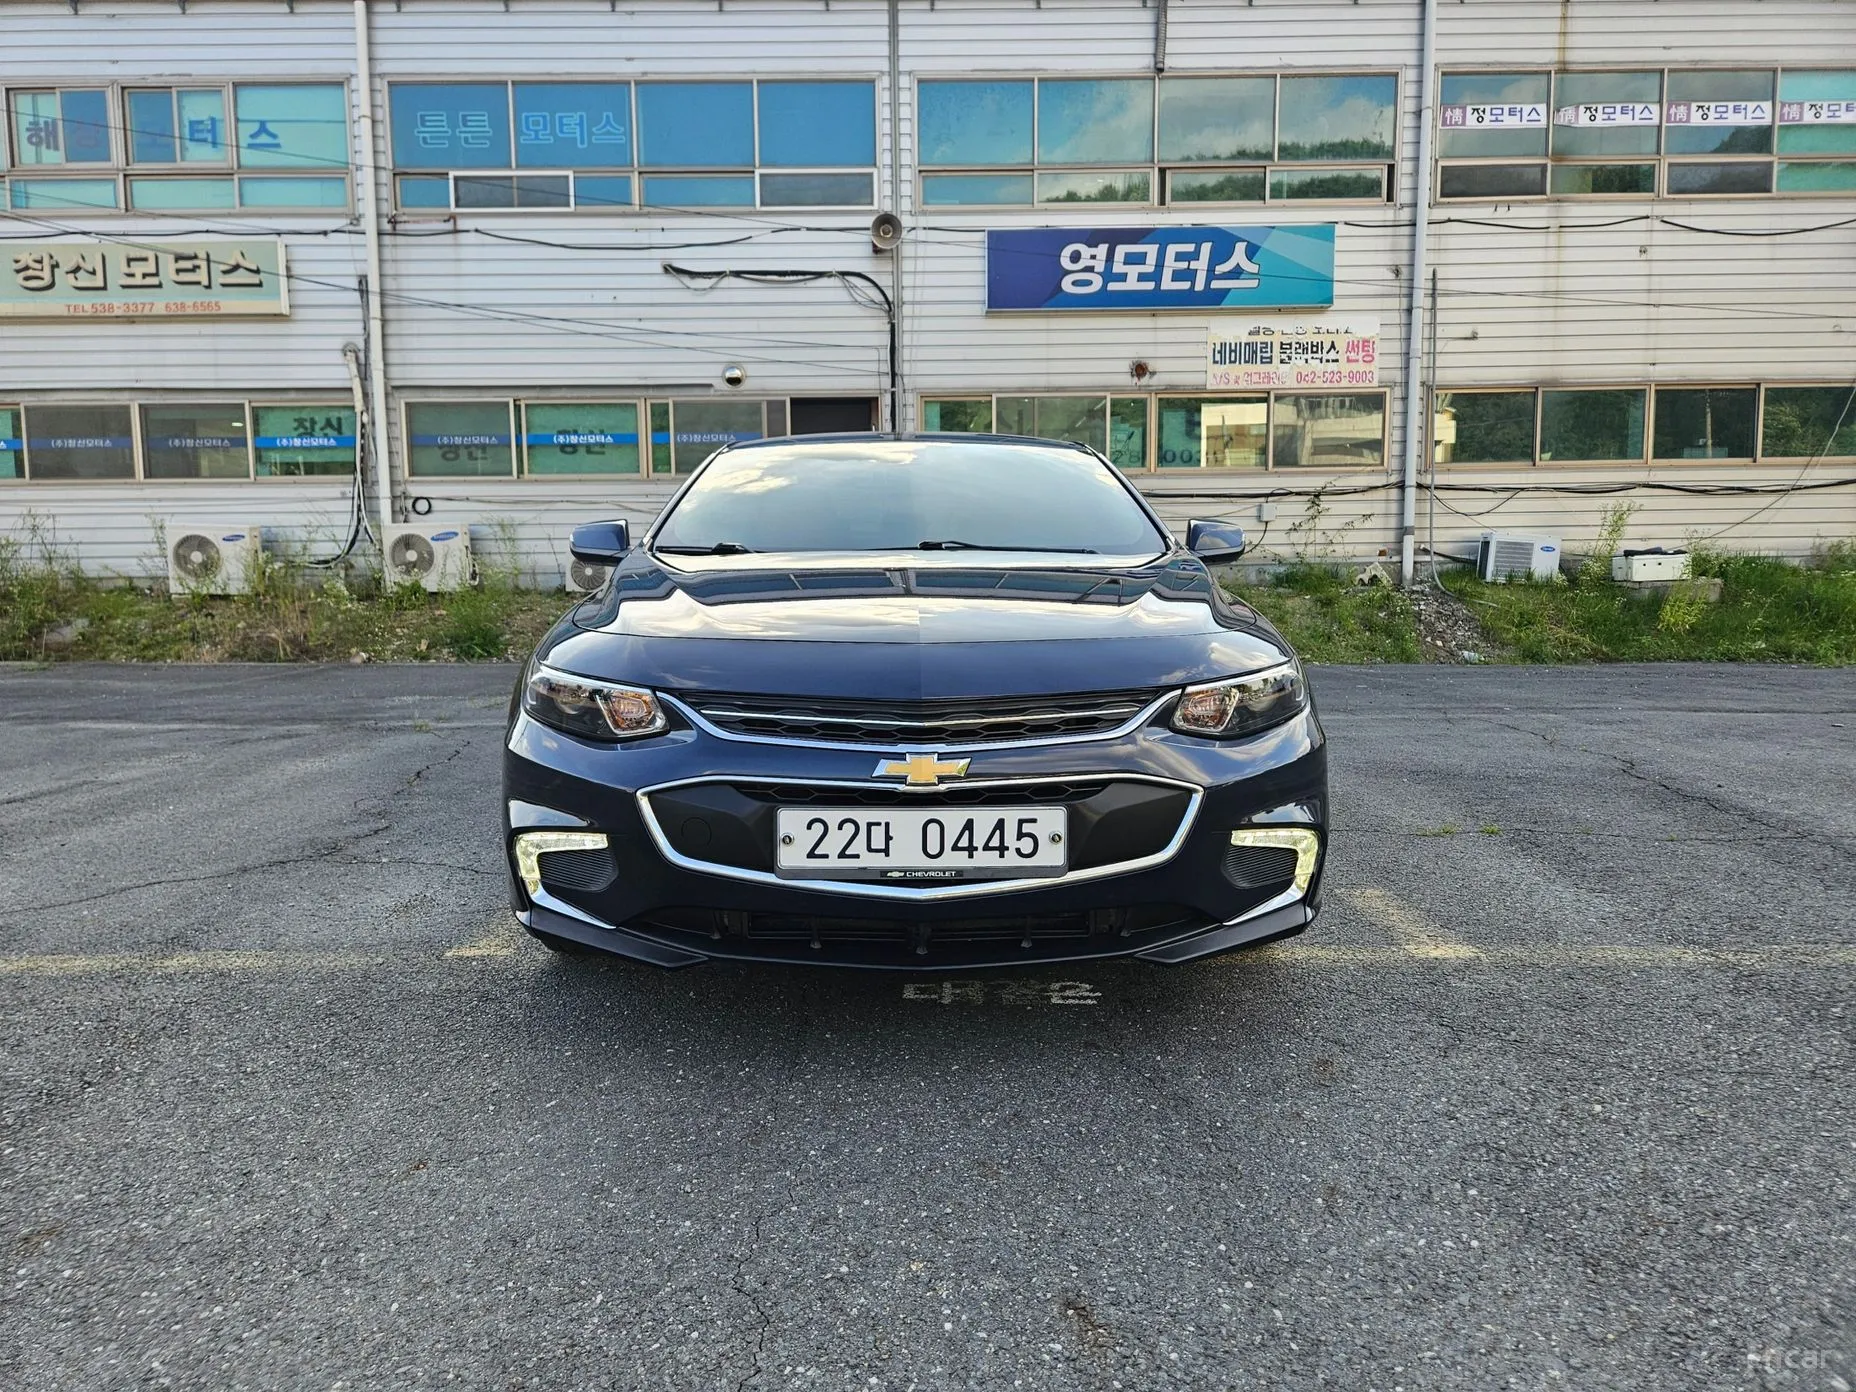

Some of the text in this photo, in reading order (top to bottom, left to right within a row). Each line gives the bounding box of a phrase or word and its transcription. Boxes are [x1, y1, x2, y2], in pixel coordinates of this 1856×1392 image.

[1470, 106, 1542, 124] 정모터스
[1583, 105, 1654, 122] 정모터스
[1695, 103, 1766, 121] 정모터스
[414, 111, 627, 149] 튼튼 모터스
[12, 248, 264, 291] 창신 모터스
[1059, 239, 1261, 295] 영모터스
[64, 300, 222, 314] TEL 538-3377 638-6565
[1212, 340, 1274, 366] 네비매립
[1344, 337, 1376, 365] 썬팅
[805, 817, 1040, 860] 22다 0445
